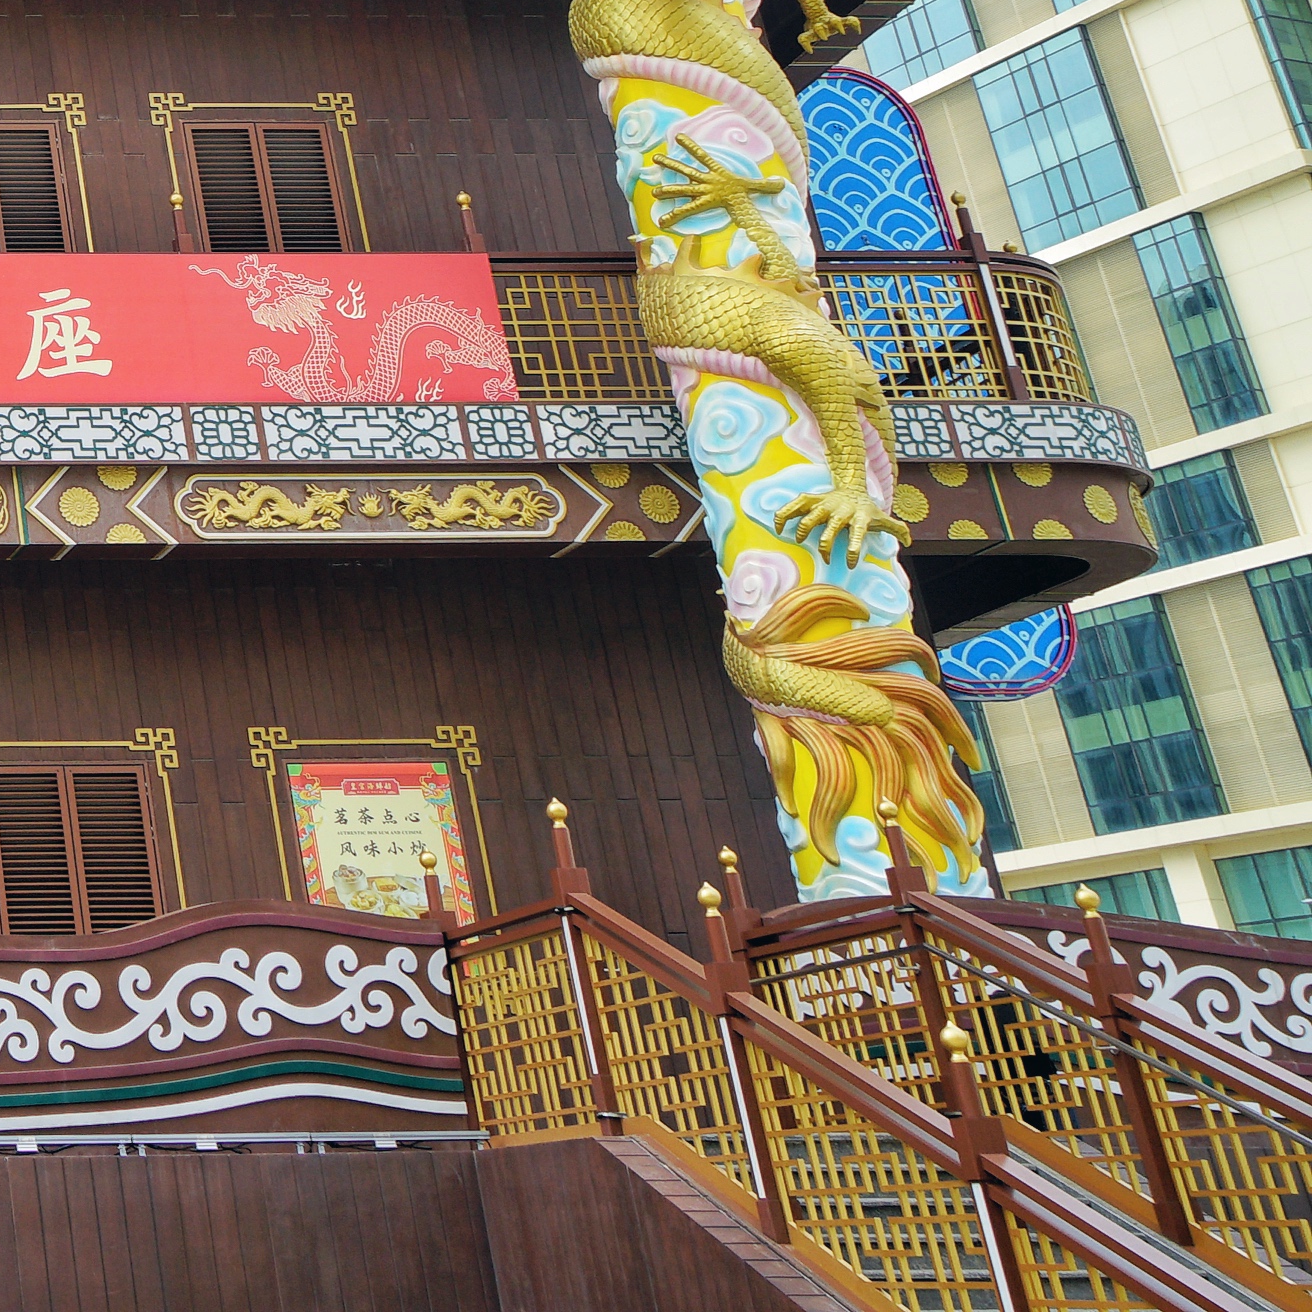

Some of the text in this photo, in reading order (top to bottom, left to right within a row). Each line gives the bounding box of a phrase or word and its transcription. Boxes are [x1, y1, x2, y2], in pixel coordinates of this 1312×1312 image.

[334, 807, 421, 825] 茗茶点心
[340, 840, 426, 858] 风味小炒
